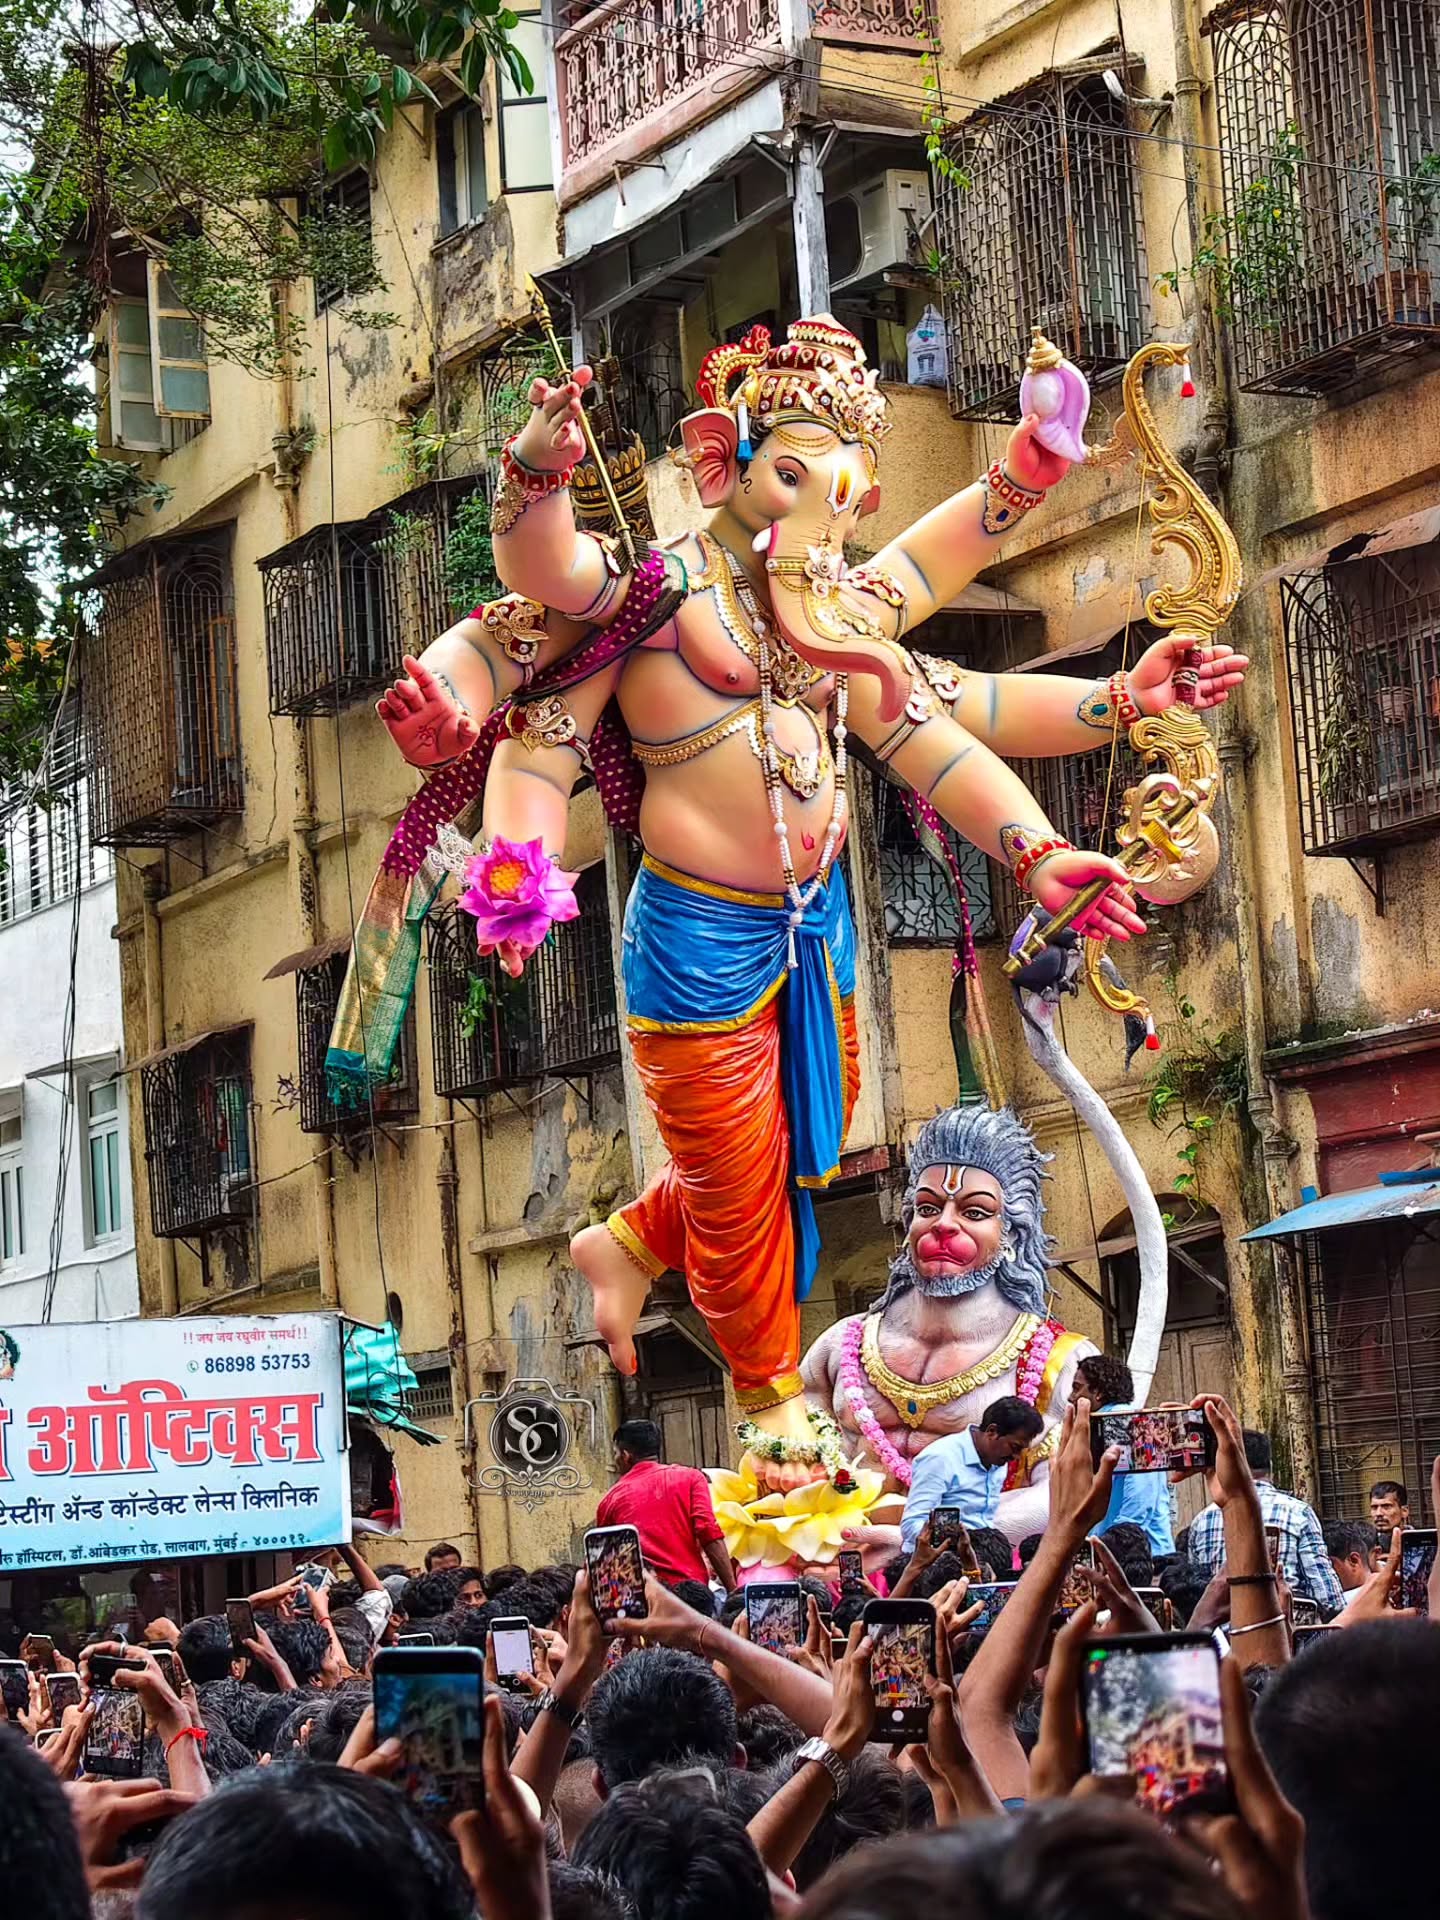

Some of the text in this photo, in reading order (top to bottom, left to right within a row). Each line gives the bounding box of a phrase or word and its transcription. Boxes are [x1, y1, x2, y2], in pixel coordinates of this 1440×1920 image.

[196, 1333, 213, 1344] जय
[216, 1332, 233, 1343] जय
[236, 1328, 266, 1344] रघुवीर
[205, 1353, 310, 1373] 86898 53753
[193, 1485, 237, 1512] लेन्स
[241, 1481, 320, 1510] क्लिनिक
